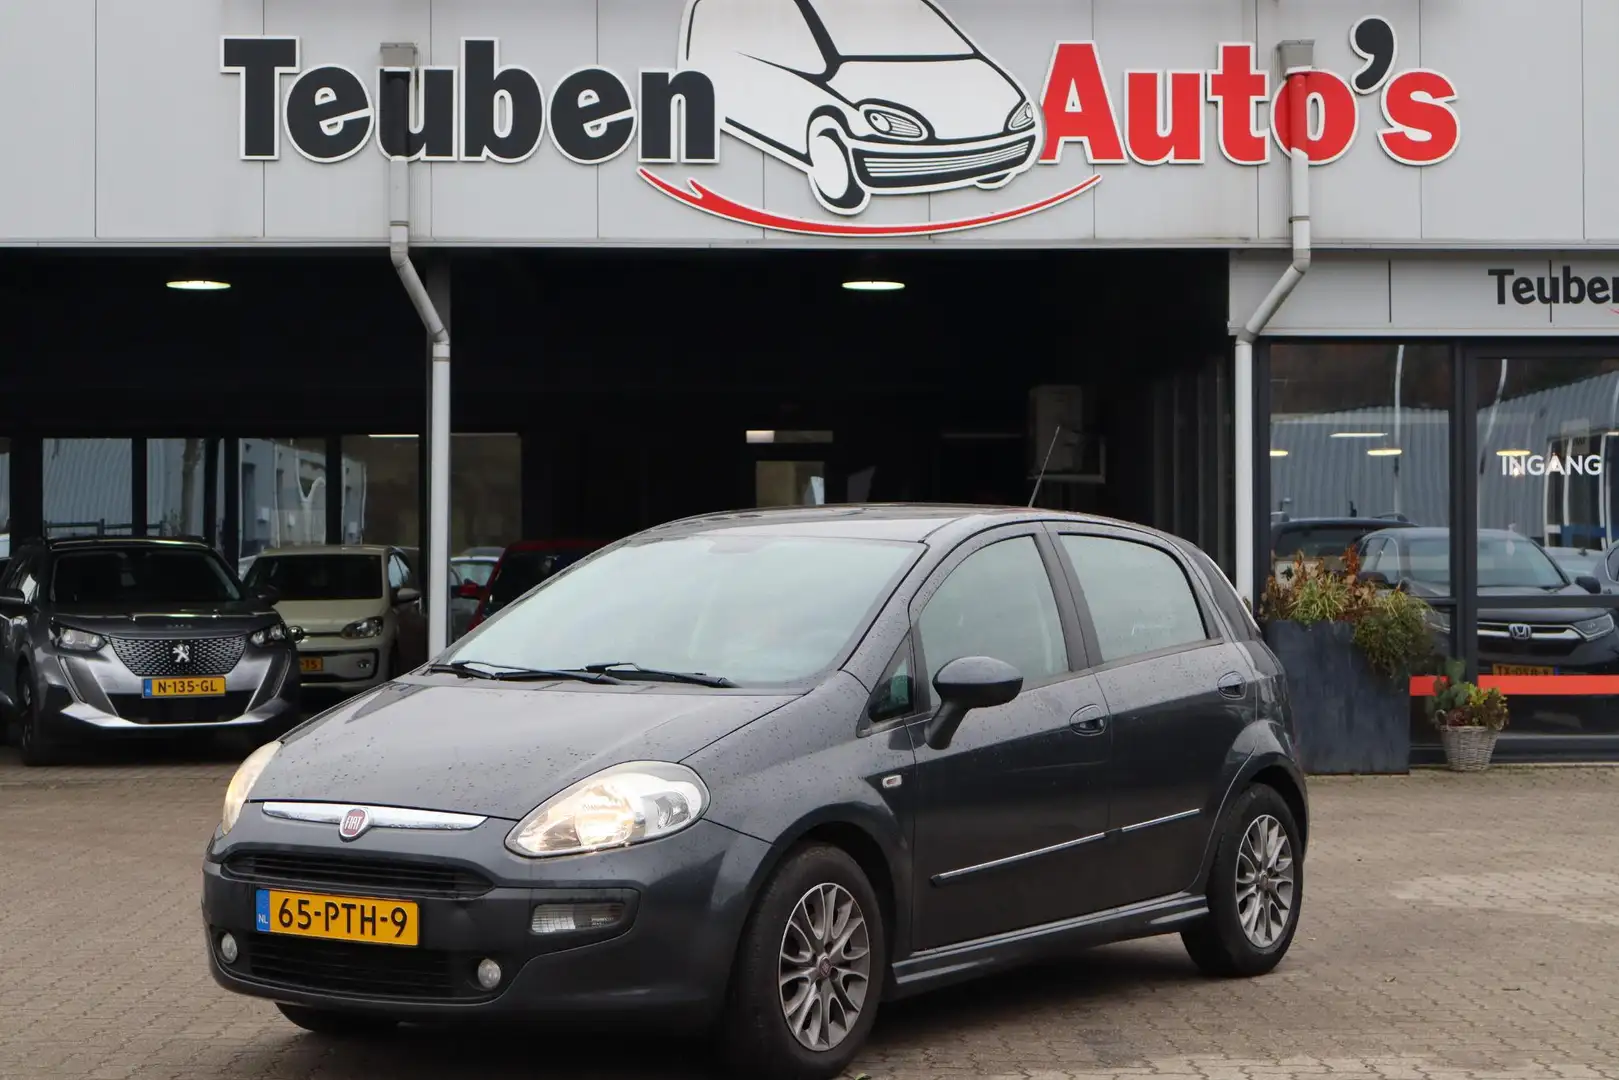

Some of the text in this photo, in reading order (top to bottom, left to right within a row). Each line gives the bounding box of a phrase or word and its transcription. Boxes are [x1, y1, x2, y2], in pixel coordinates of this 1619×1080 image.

[221, 16, 1460, 165] Teuben Auto's
[1502, 454, 1602, 476] INGANG
[158, 680, 217, 693] N-135-GL
[344, 815, 363, 831] FIAT
[258, 898, 408, 938] NL 65-PTH-9
